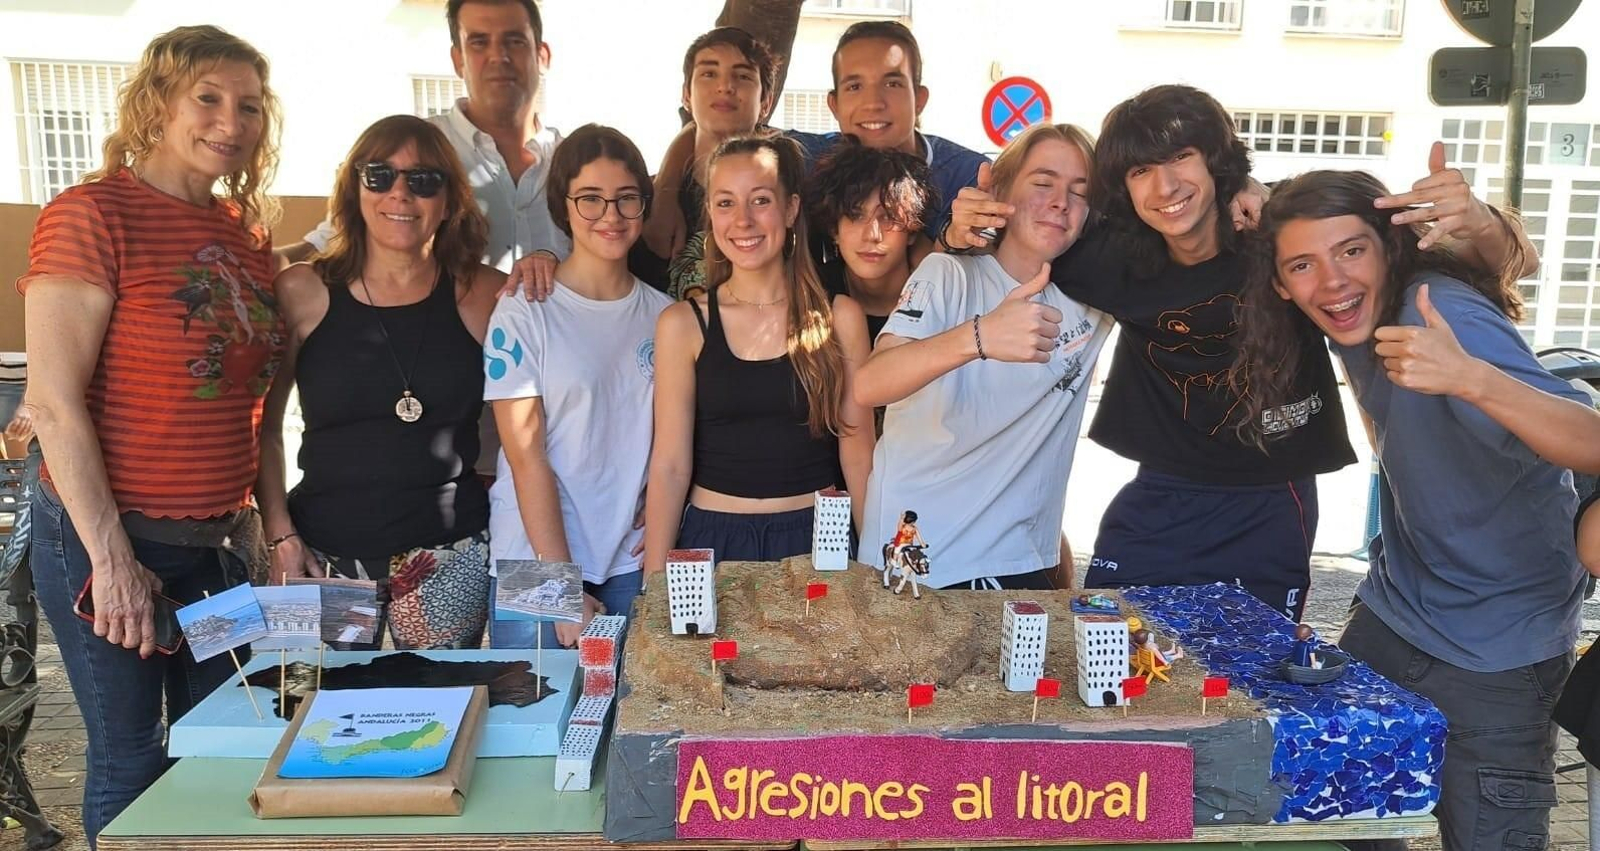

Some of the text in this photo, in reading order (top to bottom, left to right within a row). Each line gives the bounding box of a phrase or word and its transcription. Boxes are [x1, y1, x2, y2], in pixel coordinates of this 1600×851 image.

[1560, 133, 1575, 157] 3
[679, 755, 1148, 823] Agresiones al litoral
